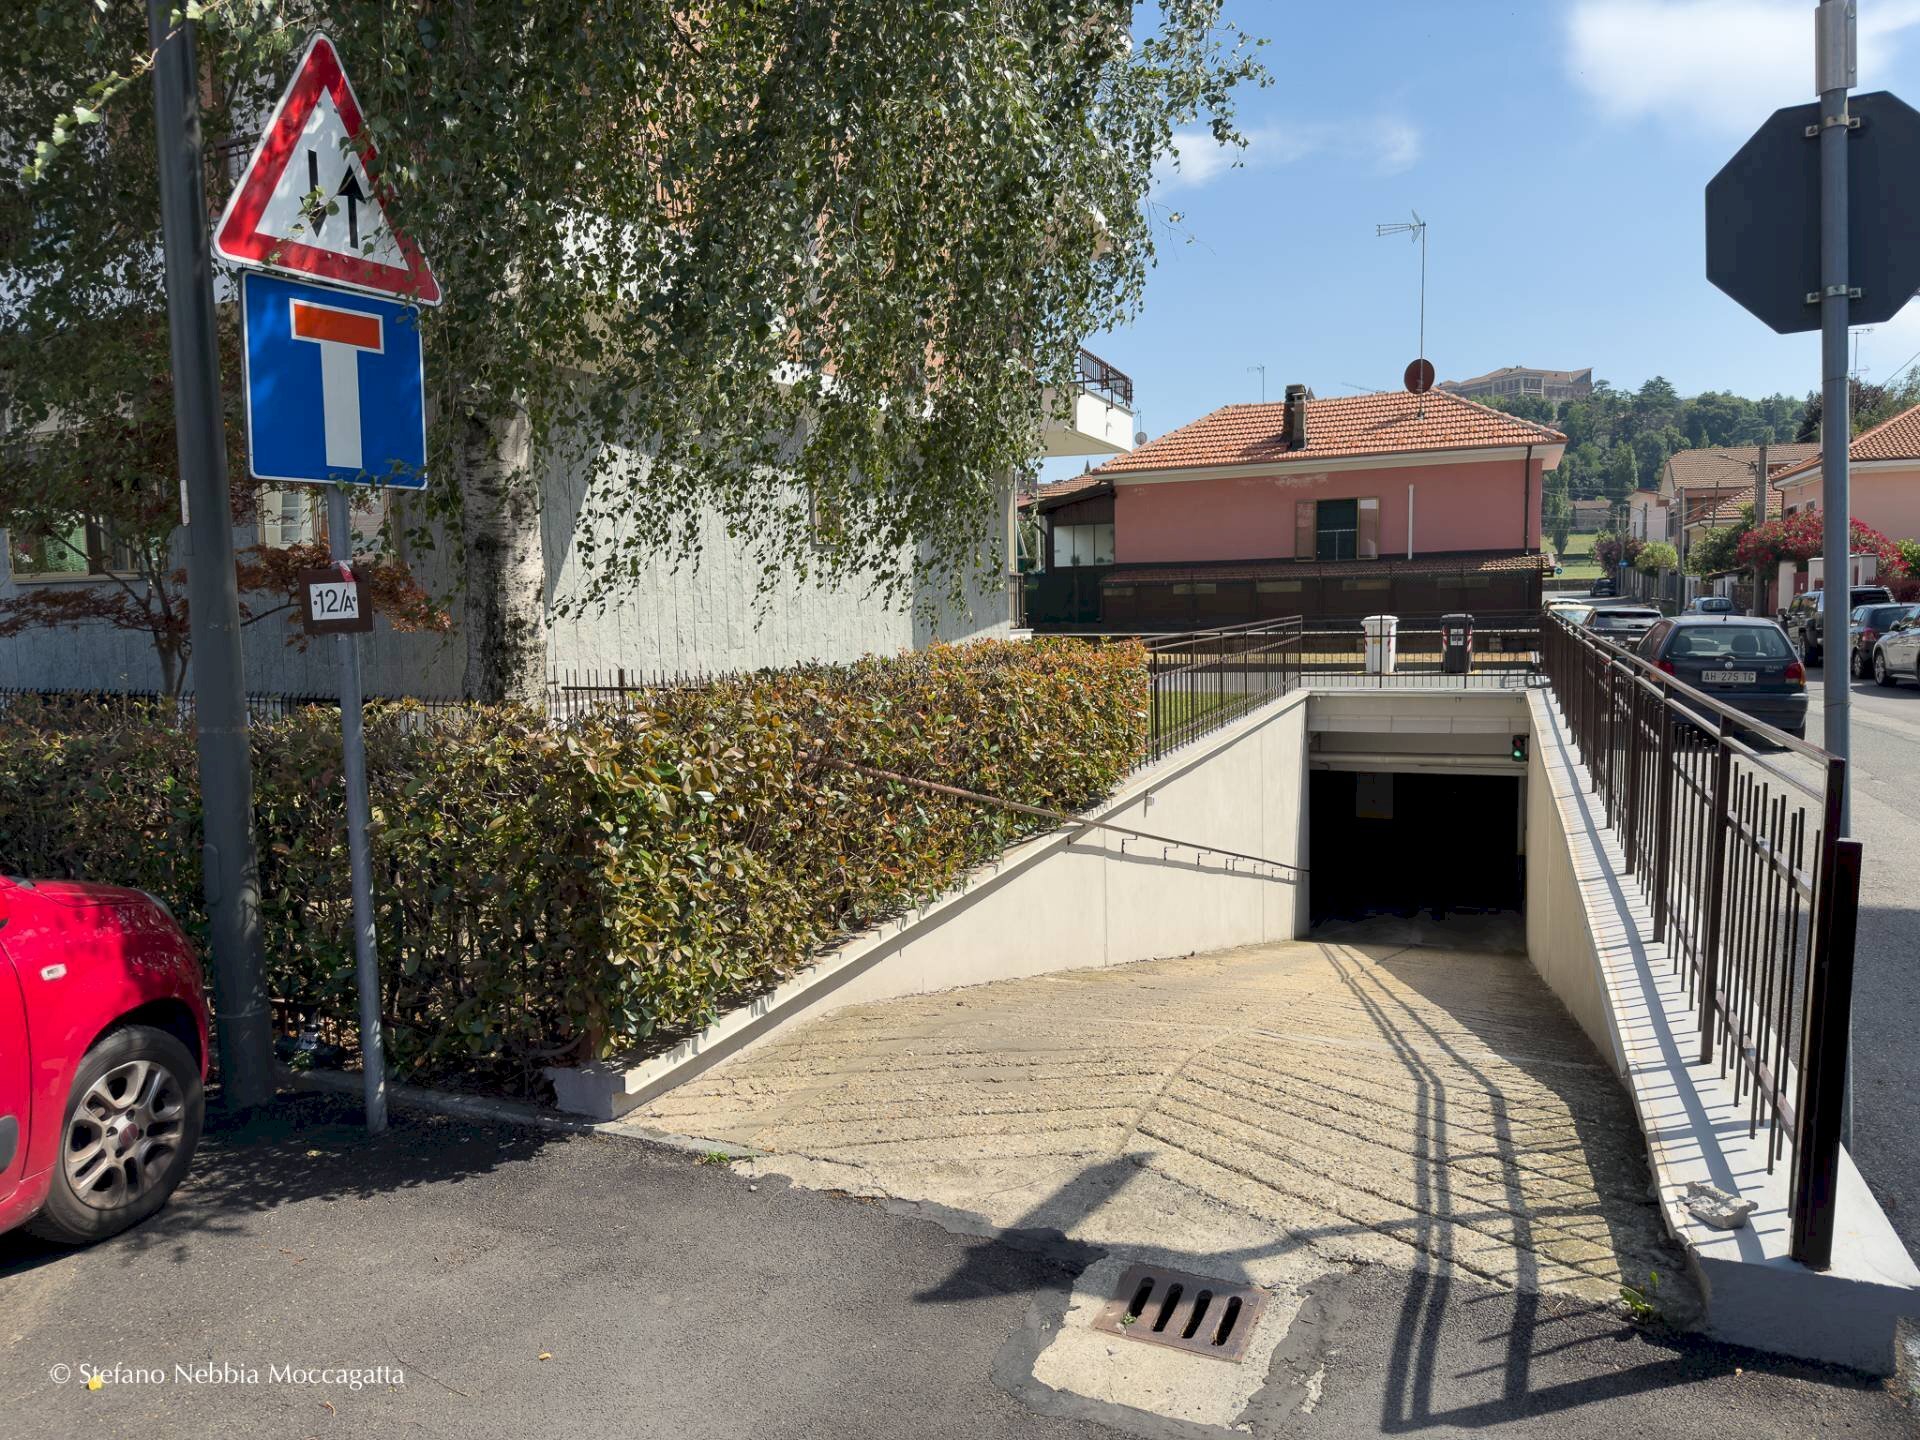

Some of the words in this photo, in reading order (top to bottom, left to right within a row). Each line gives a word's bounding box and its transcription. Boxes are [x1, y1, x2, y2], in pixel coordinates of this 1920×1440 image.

[315, 589, 354, 613] 12/A
[1704, 671, 1717, 681] AH
[1721, 671, 1739, 681] 275
